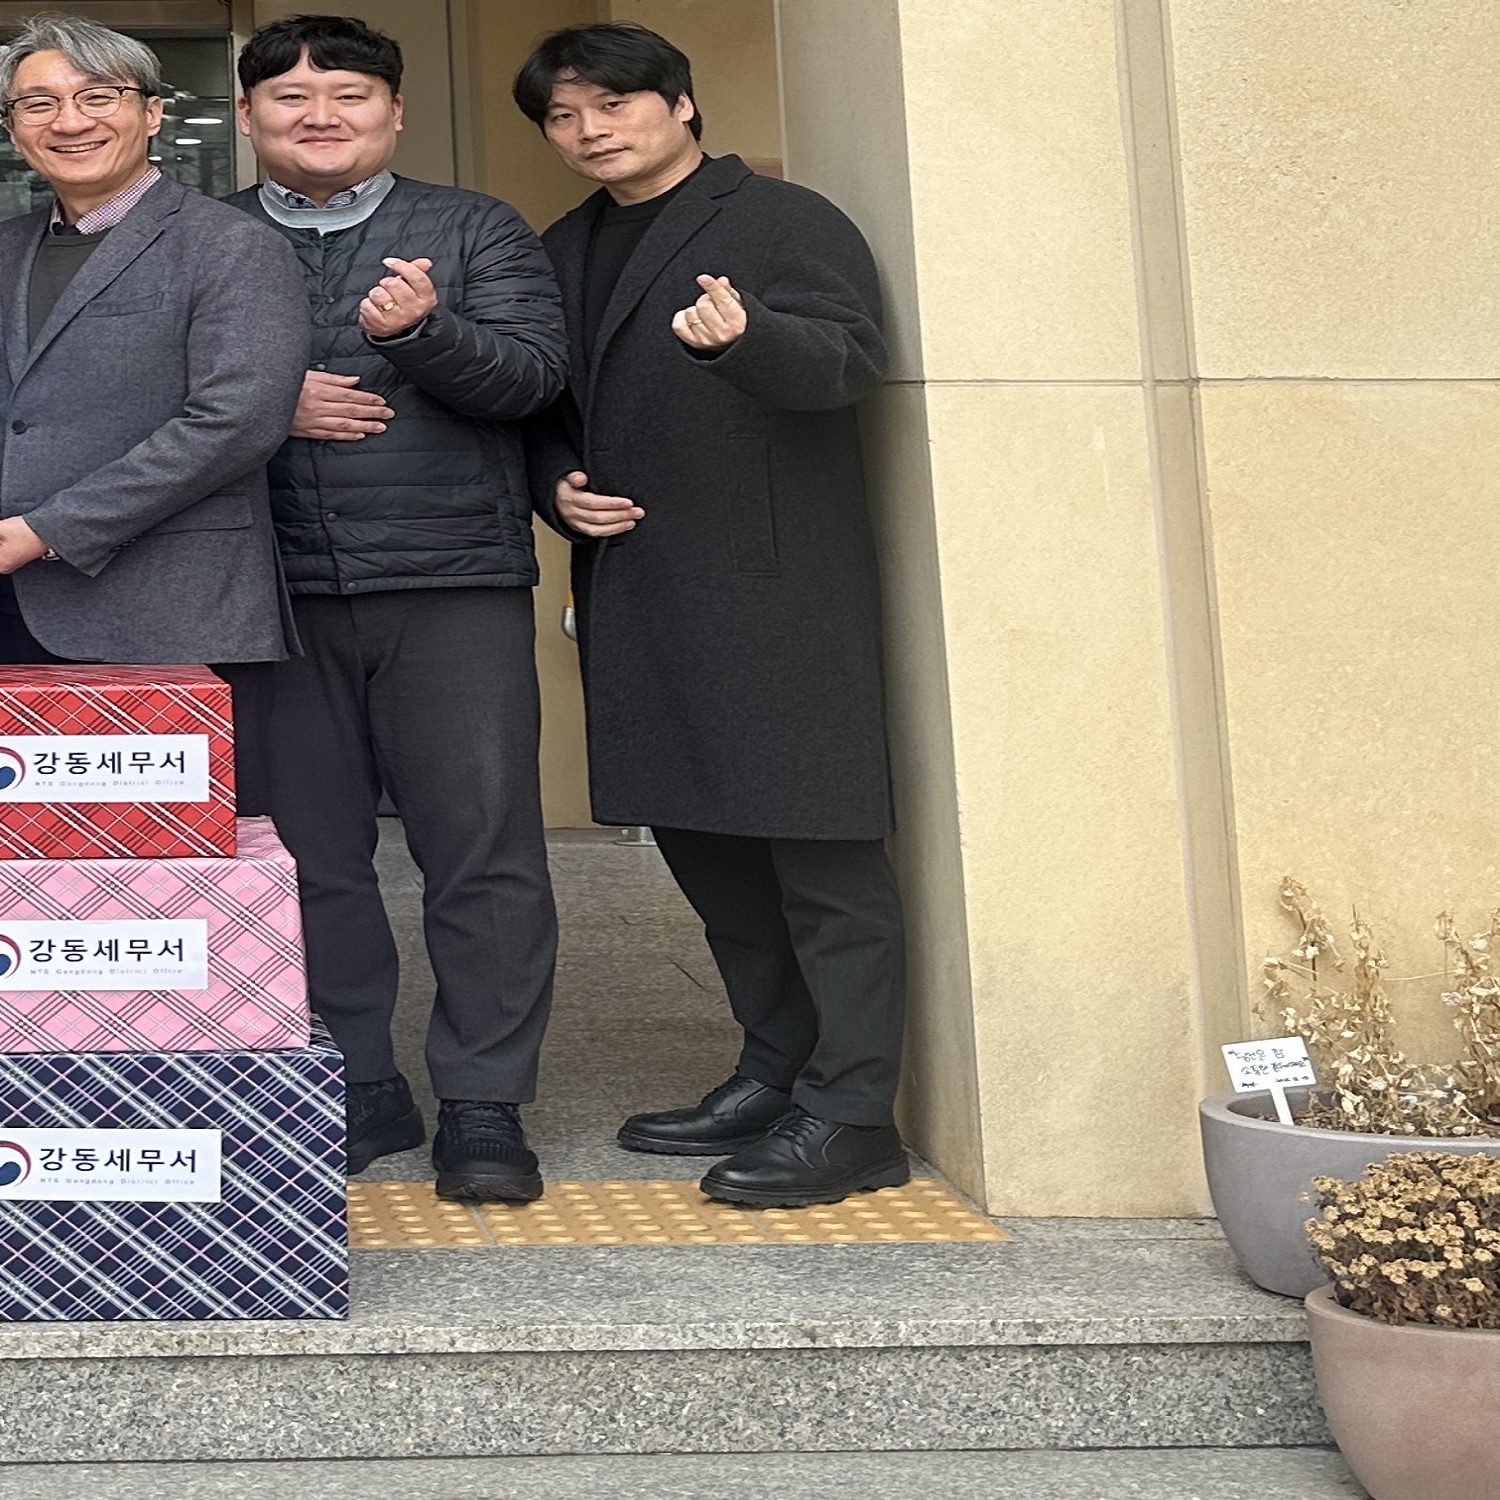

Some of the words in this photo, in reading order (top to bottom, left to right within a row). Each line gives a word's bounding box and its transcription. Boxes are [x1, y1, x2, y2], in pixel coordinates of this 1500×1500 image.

[33, 750, 186, 774] 강동세무서
[29, 938, 184, 962] 강동세무서
[39, 1147, 196, 1172] 강동세무서
